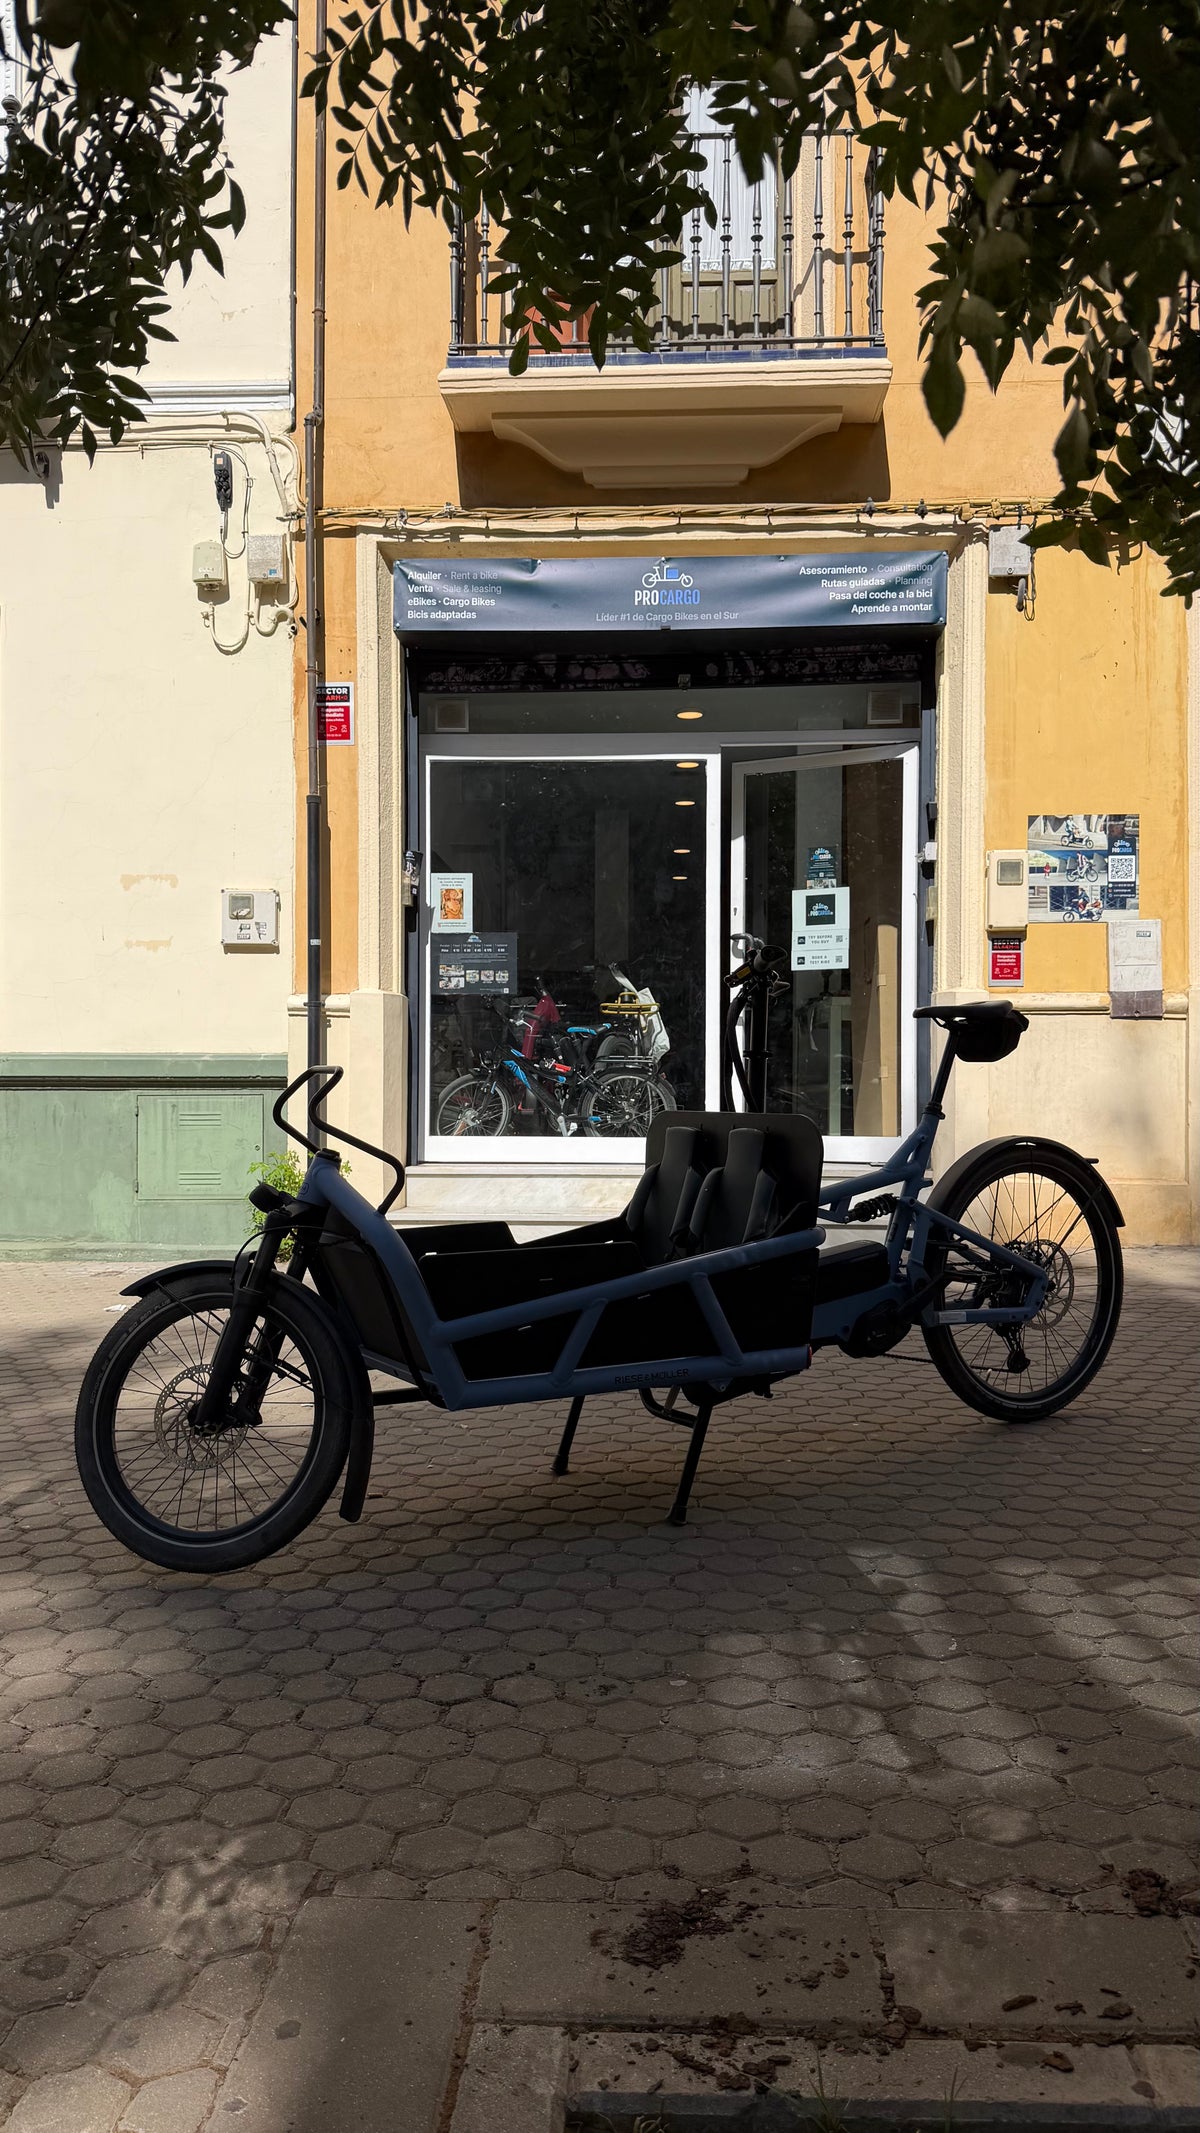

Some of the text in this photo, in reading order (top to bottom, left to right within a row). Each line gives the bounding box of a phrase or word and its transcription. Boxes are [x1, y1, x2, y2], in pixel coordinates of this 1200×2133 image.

[799, 563, 933, 576] Asesoramiento Consultation
[407, 571, 442, 581] Alquiler
[450, 571, 471, 580] Rent
[480, 570, 498, 580] bike
[821, 576, 932, 589] Rutas guiadas Planning
[408, 584, 502, 595] Venta Sale & leasing
[829, 591, 851, 600] Pasa
[853, 590, 867, 599] del
[869, 590, 896, 599] coche
[906, 589, 914, 598] la
[916, 589, 933, 598] bici
[407, 597, 496, 608] eBikes Cargo Bikes
[634, 589, 700, 606] PROCARGO
[851, 604, 890, 615] Aprende
[900, 603, 932, 612] montar
[407, 610, 477, 621] Bicis adaptadas
[596, 612, 619, 621] Líder
[620, 613, 631, 621] #1
[632, 612, 644, 621] de
[645, 612, 672, 623] Cargo
[675, 611, 699, 620] Bikes
[714, 611, 721, 620] el
[723, 611, 739, 620] Sur
